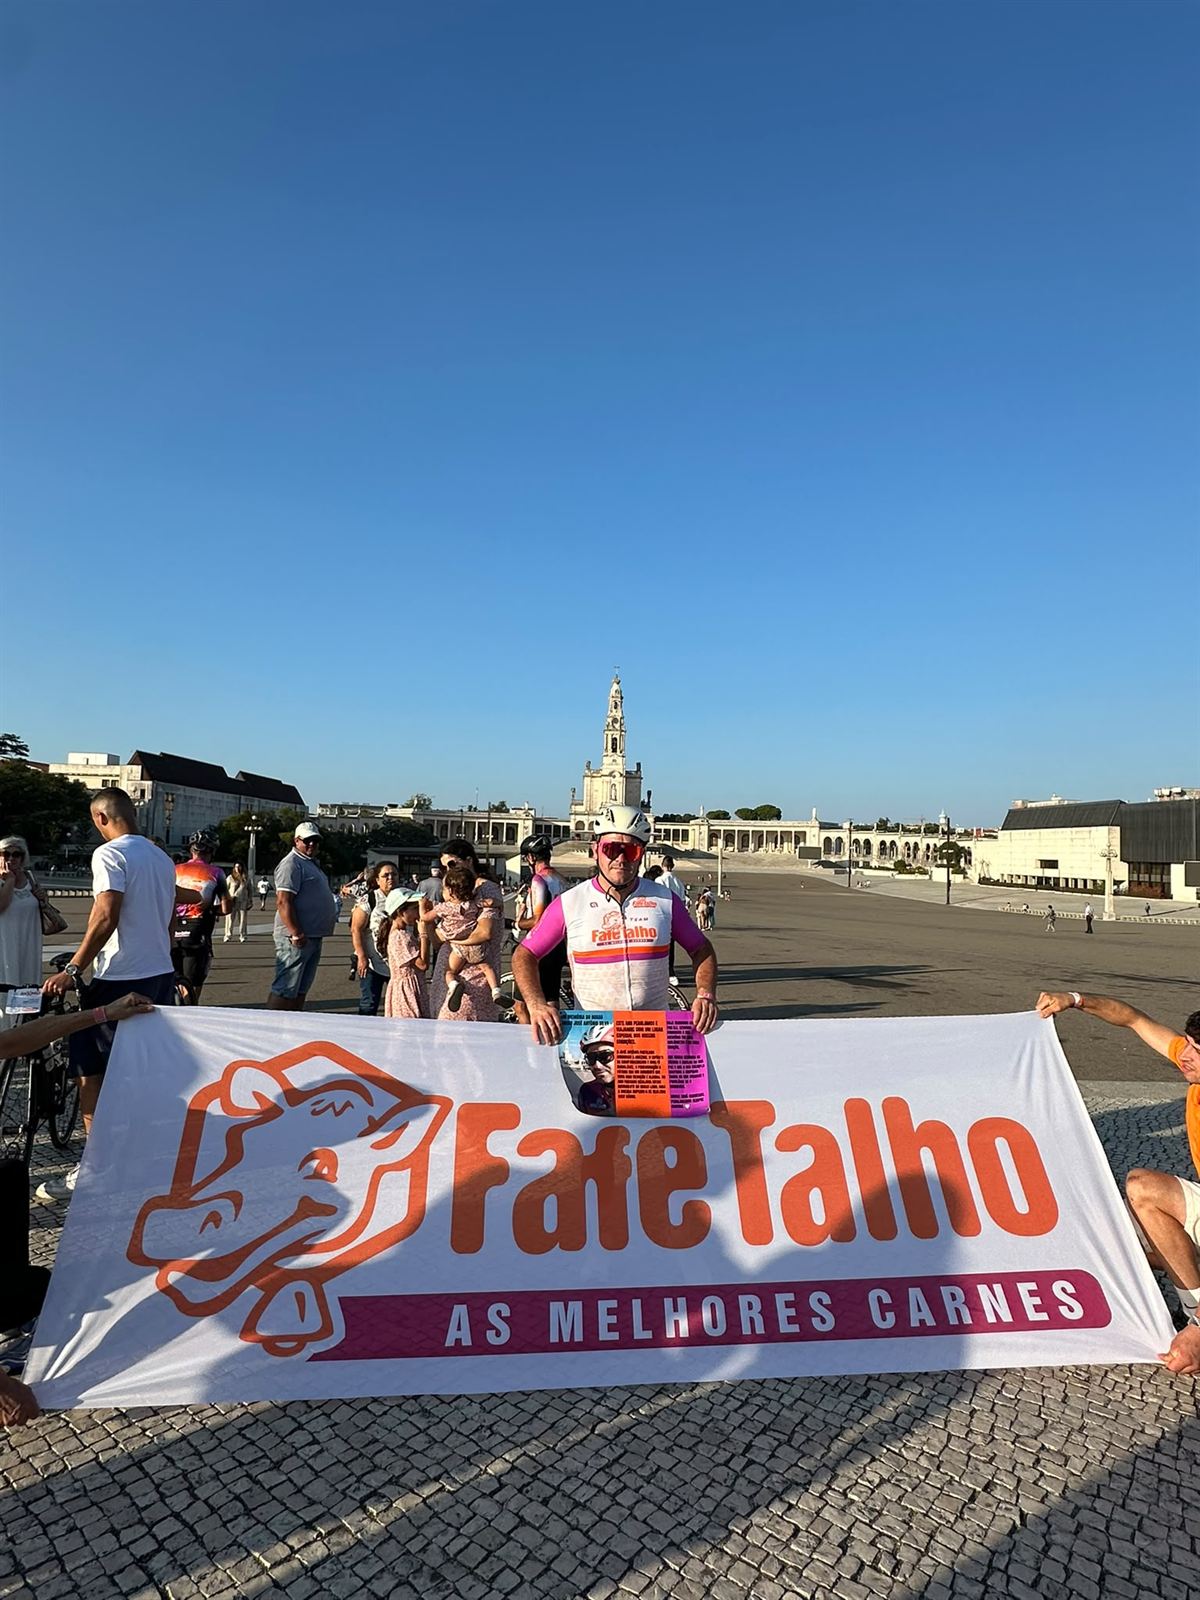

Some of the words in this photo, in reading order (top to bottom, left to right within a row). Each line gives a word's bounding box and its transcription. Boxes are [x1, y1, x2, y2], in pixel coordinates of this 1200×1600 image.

[445, 1302, 511, 1347] AS
[549, 1290, 836, 1344] MELHORES
[869, 1280, 1084, 1329] CARNES
